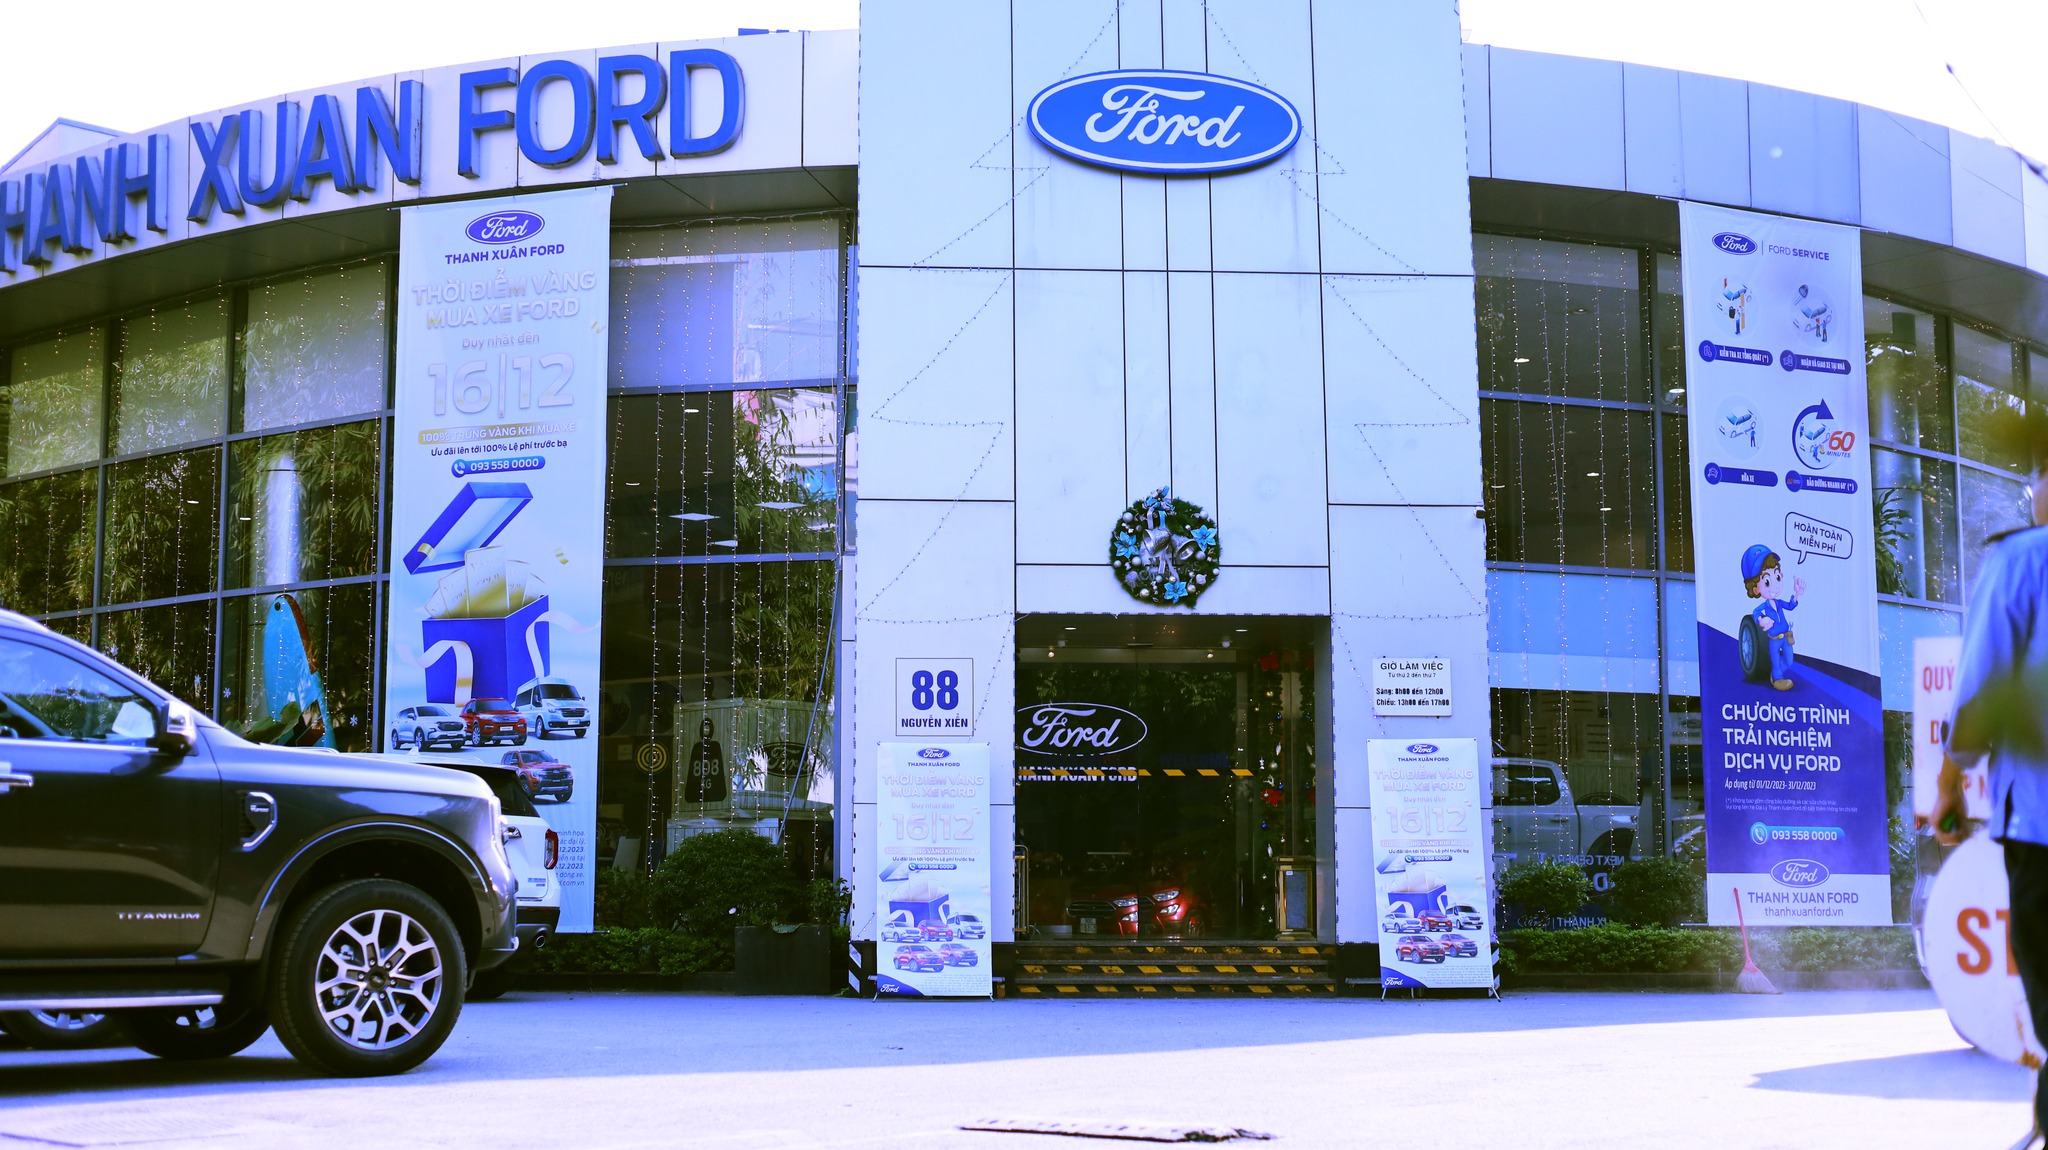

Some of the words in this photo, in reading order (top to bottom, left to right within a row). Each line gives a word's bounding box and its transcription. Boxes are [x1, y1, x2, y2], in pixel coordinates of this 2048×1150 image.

[1085, 84, 1246, 149] Ford
[188, 79, 424, 223] XUAN
[458, 48, 746, 179] FORD
[481, 215, 528, 239] Ford
[1721, 235, 1749, 253] Ford
[1768, 244, 1791, 256] FORD
[1792, 248, 1830, 261] SERVICE
[445, 249, 489, 265] THANH
[492, 244, 527, 261] XUÂN
[529, 243, 565, 258] FORD
[412, 278, 465, 306] THỜI
[470, 267, 528, 301] ĐIỂM
[531, 269, 597, 295] VÀNG
[427, 308, 478, 330] MUA
[483, 303, 513, 325] XE
[516, 297, 580, 321] FORD
[462, 337, 485, 350] Duy
[487, 331, 515, 346] nhất
[517, 329, 540, 345] đến
[422, 432, 450, 443] 100%
[488, 426, 516, 438] VÀNG
[518, 425, 535, 435] KHI
[537, 423, 560, 434] MUA
[563, 421, 576, 432] XE
[1828, 430, 1856, 451] 60
[431, 448, 443, 457] Ưu
[443, 446, 456, 456] đãi
[457, 446, 470, 455] lên
[471, 445, 482, 454] tới
[483, 444, 508, 453] 100%
[509, 443, 518, 452] Lệ
[519, 441, 533, 451] phí
[534, 440, 555, 449] trước
[557, 439, 568, 448] bạ
[470, 462, 490, 472] 093
[491, 460, 510, 470] 558
[511, 458, 539, 468] 0000
[1794, 521, 1818, 535] HOÀN
[1819, 527, 1843, 542] TOÀN
[1799, 535, 1820, 549] MIỄN
[1821, 541, 1836, 553] PHÍ
[1380, 660, 1397, 670] GIỜ
[1400, 661, 1419, 670] LÀM
[1422, 660, 1443, 671] VIỆC
[912, 669, 958, 710] 88
[1411, 687, 1423, 695] đến
[1417, 698, 1429, 706] đến
[901, 714, 942, 728] NGUYỄN
[1721, 701, 1797, 723] CHƯƠNG
[1798, 705, 1850, 725] TRÌNH
[1023, 707, 1122, 748] Ford
[1722, 723, 1762, 746] TRẢI
[1765, 727, 1832, 751] NGHIỆM
[923, 749, 945, 758] Ford
[1412, 744, 1433, 753] Ford
[1724, 752, 1765, 773] DỊCH
[1768, 754, 1793, 774] VỤ
[1795, 755, 1841, 772] FORD
[882, 773, 913, 785] THỜI
[949, 773, 984, 785] VÀNG
[1374, 767, 1404, 780] THỜI
[1439, 767, 1474, 779] VÀNG
[891, 787, 920, 797] MUA
[922, 787, 939, 797] XE
[941, 787, 976, 797] FORD
[1382, 782, 1412, 792] MUA
[1413, 781, 1430, 791] XE
[1432, 781, 1466, 791] FORD
[1725, 777, 1733, 790] Áp
[1733, 779, 1748, 790] dụng
[1788, 781, 1816, 790] 31/12/2023
[1771, 830, 1791, 840] 093
[1792, 831, 1809, 841] 558
[1811, 831, 1838, 841] 0000
[1782, 863, 1818, 883] Ford
[1748, 892, 1790, 904] THANH
[1792, 892, 1825, 904] XUAN
[1827, 892, 1859, 904] FORD
[117, 912, 200, 920] TITANIUM
[1765, 907, 1844, 917] thanhxuanford.vn
[1956, 907, 2020, 976] ST
[880, 983, 900, 993] Ford
[1384, 976, 1404, 985] Ford
